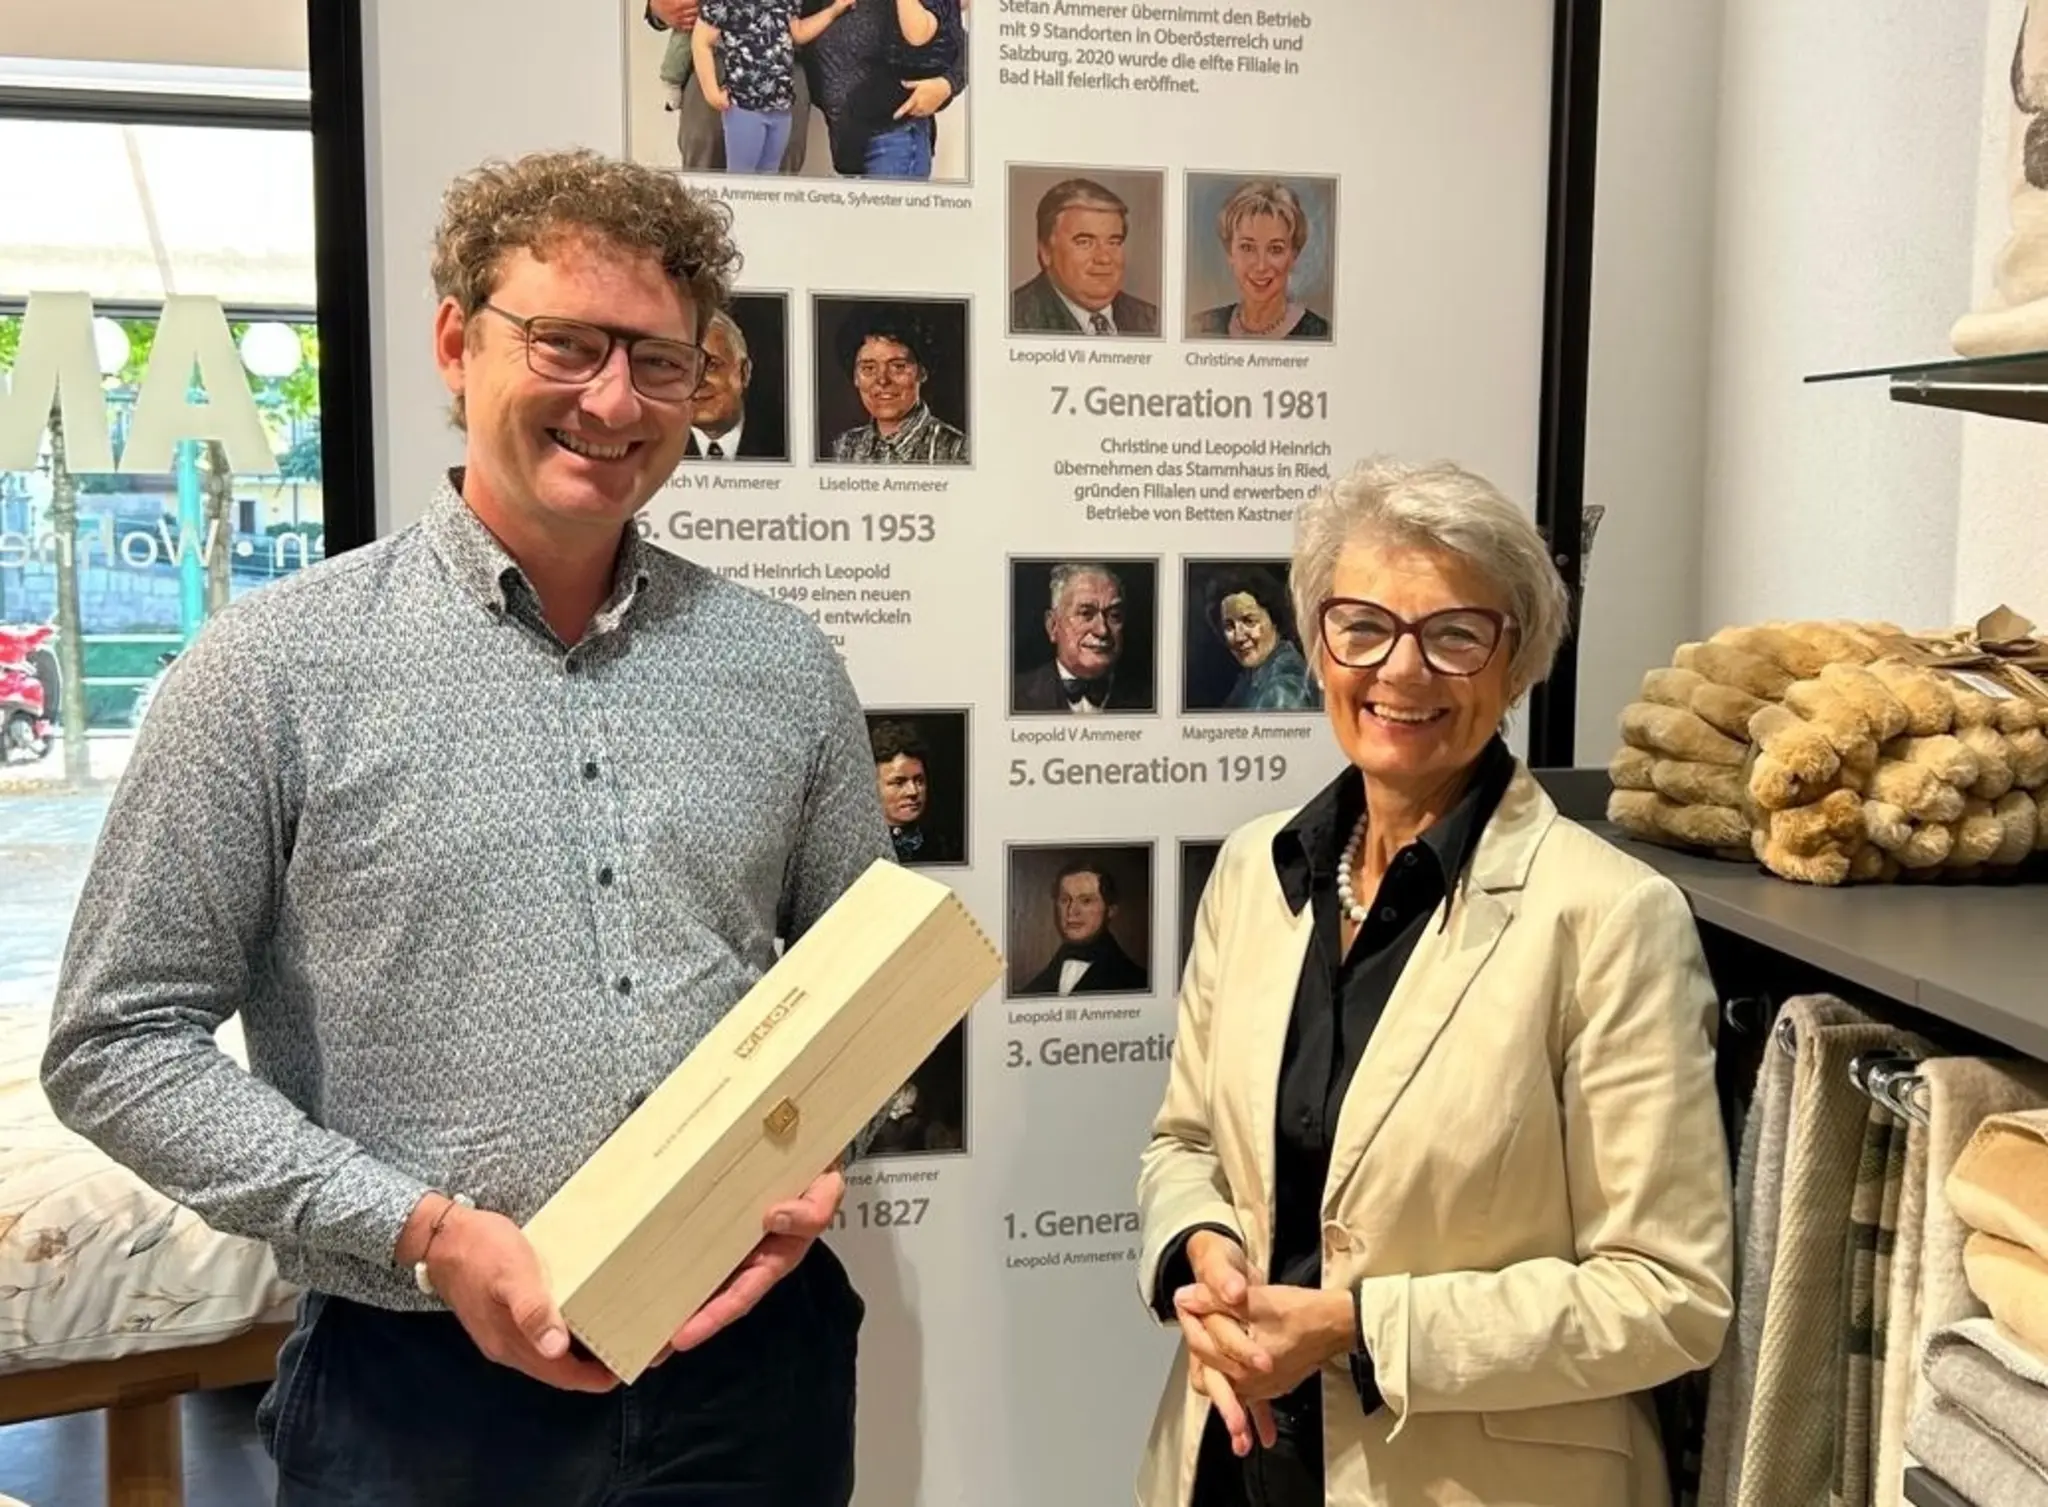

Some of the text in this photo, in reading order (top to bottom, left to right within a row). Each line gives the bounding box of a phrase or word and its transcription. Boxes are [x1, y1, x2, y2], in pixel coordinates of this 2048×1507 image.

[1000, 0, 1311, 28] Stefan Ammerer übernimmt den Betrieb
[1000, 21, 1303, 51] mit 9 Standorten in Oberösterreich und
[1000, 44, 1299, 74] Salzburg. 2020 wurde die elfte Filiale in
[1000, 68, 1199, 93] Bad Hall feierlich eröffnet.
[721, 187, 781, 200] Ammerer
[784, 189, 804, 202] mit
[808, 190, 845, 204] Greta,
[847, 191, 902, 207] Sylvester
[905, 195, 930, 207] und
[933, 195, 972, 208] Timon
[1009, 349, 1066, 364] Leopold
[1089, 350, 1152, 365] Ammerer
[1185, 352, 1309, 368] Christine Ammerer
[1051, 386, 1327, 419] 7. Generation 1981
[1100, 437, 1331, 459] Christine und Leopold Heinrich
[1054, 460, 1331, 480] übernehmen das Stammhaus in Ried,
[663, 475, 781, 490] rich VI Ammerer
[819, 477, 949, 492] Liselotte Ammerer
[1074, 483, 1140, 501] gründen
[1144, 483, 1196, 498] Filialen
[1200, 483, 1229, 499] und
[1233, 484, 1304, 499] erwerben
[1086, 505, 1293, 521] Betriebe von Betten Kastner
[634, 509, 936, 543] 6. Generation 1953
[753, 564, 821, 579] Heinrich
[825, 565, 890, 582] Leopold
[768, 586, 911, 601] 1949 einen neuen
[824, 609, 912, 624] entwickeln
[1011, 728, 1143, 744] Leopold V Ammerer
[1182, 726, 1312, 743] Margarete Ammerer
[1009, 754, 1287, 787] 5. Generation 1919
[1008, 1007, 1141, 1024] Leopold III Ammerer
[1006, 1039, 1032, 1068] 3.
[845, 1169, 940, 1185] rese Ammerer
[857, 1197, 930, 1229] 1827
[1004, 1210, 1140, 1239] 1. Genera
[1006, 1253, 1061, 1269] Leopold
[1063, 1249, 1125, 1265] Ammerer
[1126, 1247, 1137, 1260] &
